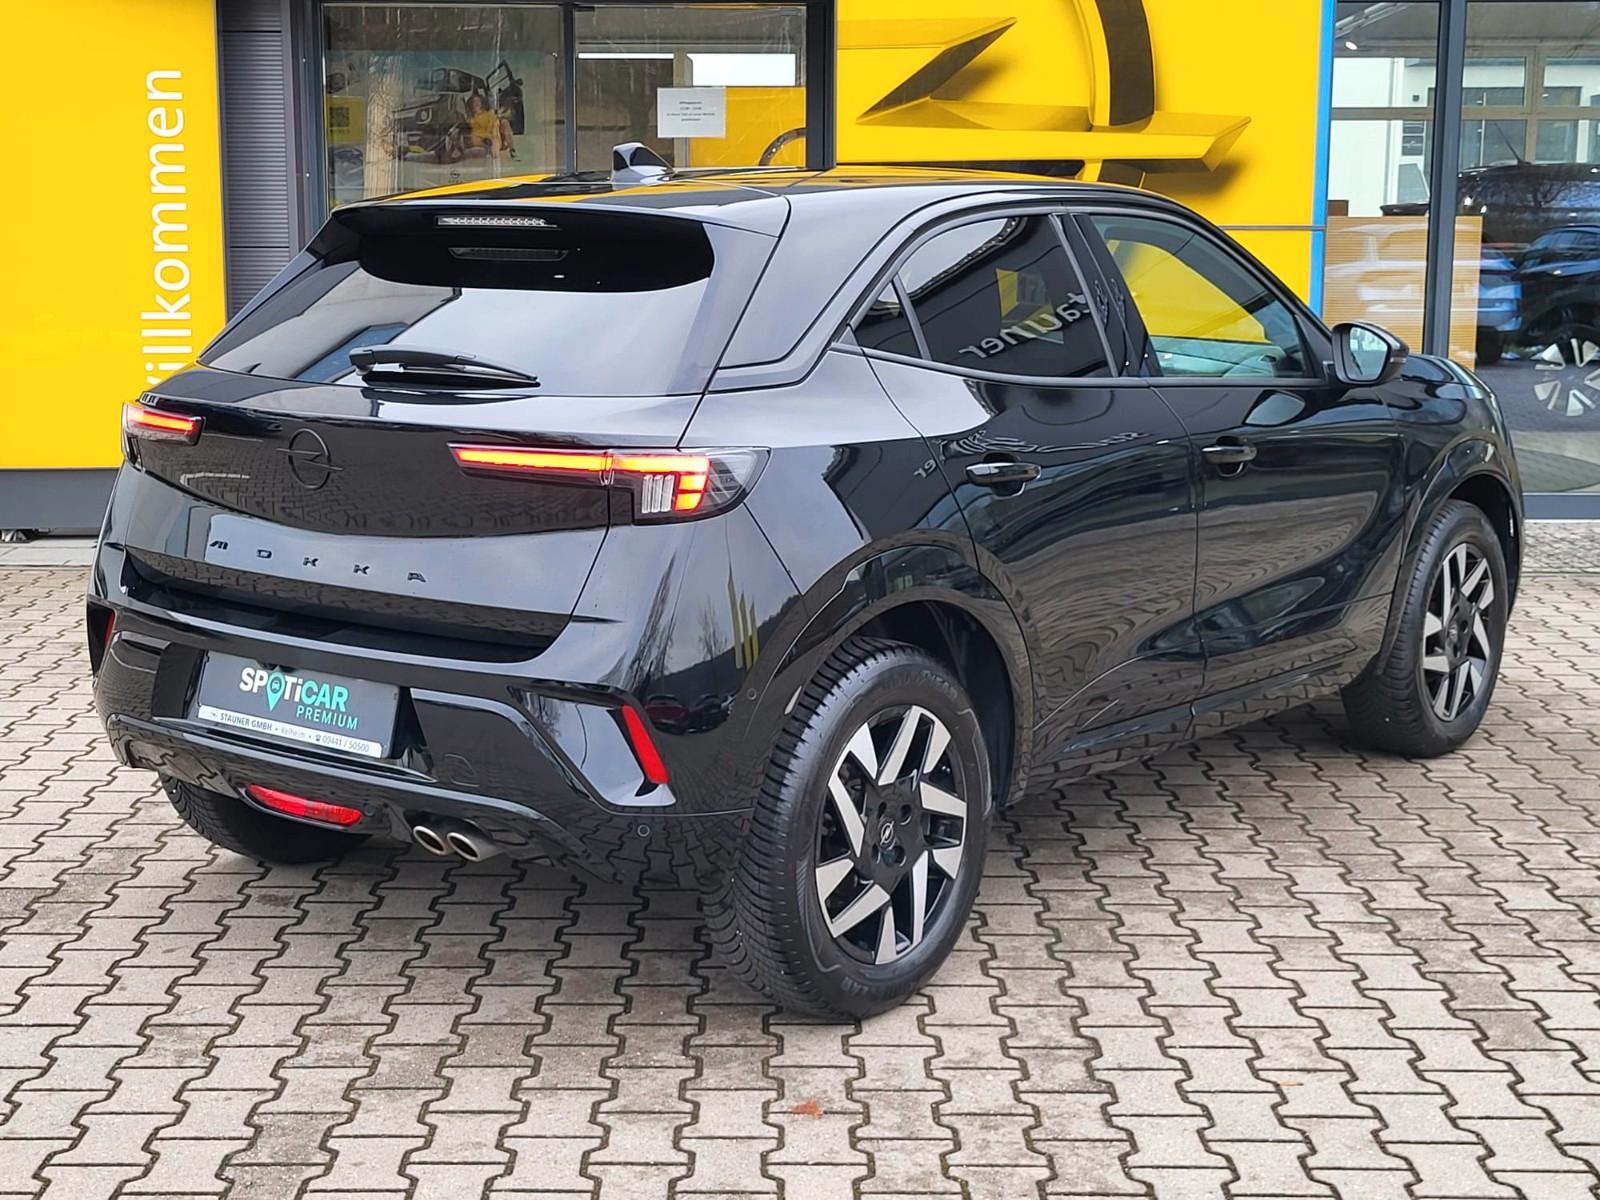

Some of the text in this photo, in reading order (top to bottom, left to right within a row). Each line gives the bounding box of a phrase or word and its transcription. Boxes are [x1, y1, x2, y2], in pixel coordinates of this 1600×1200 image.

[140, 70, 192, 385] illkommen
[209, 540, 426, 583] MOKKA
[220, 712, 250, 727] STAUNER
[296, 705, 358, 731] PREMIUM
